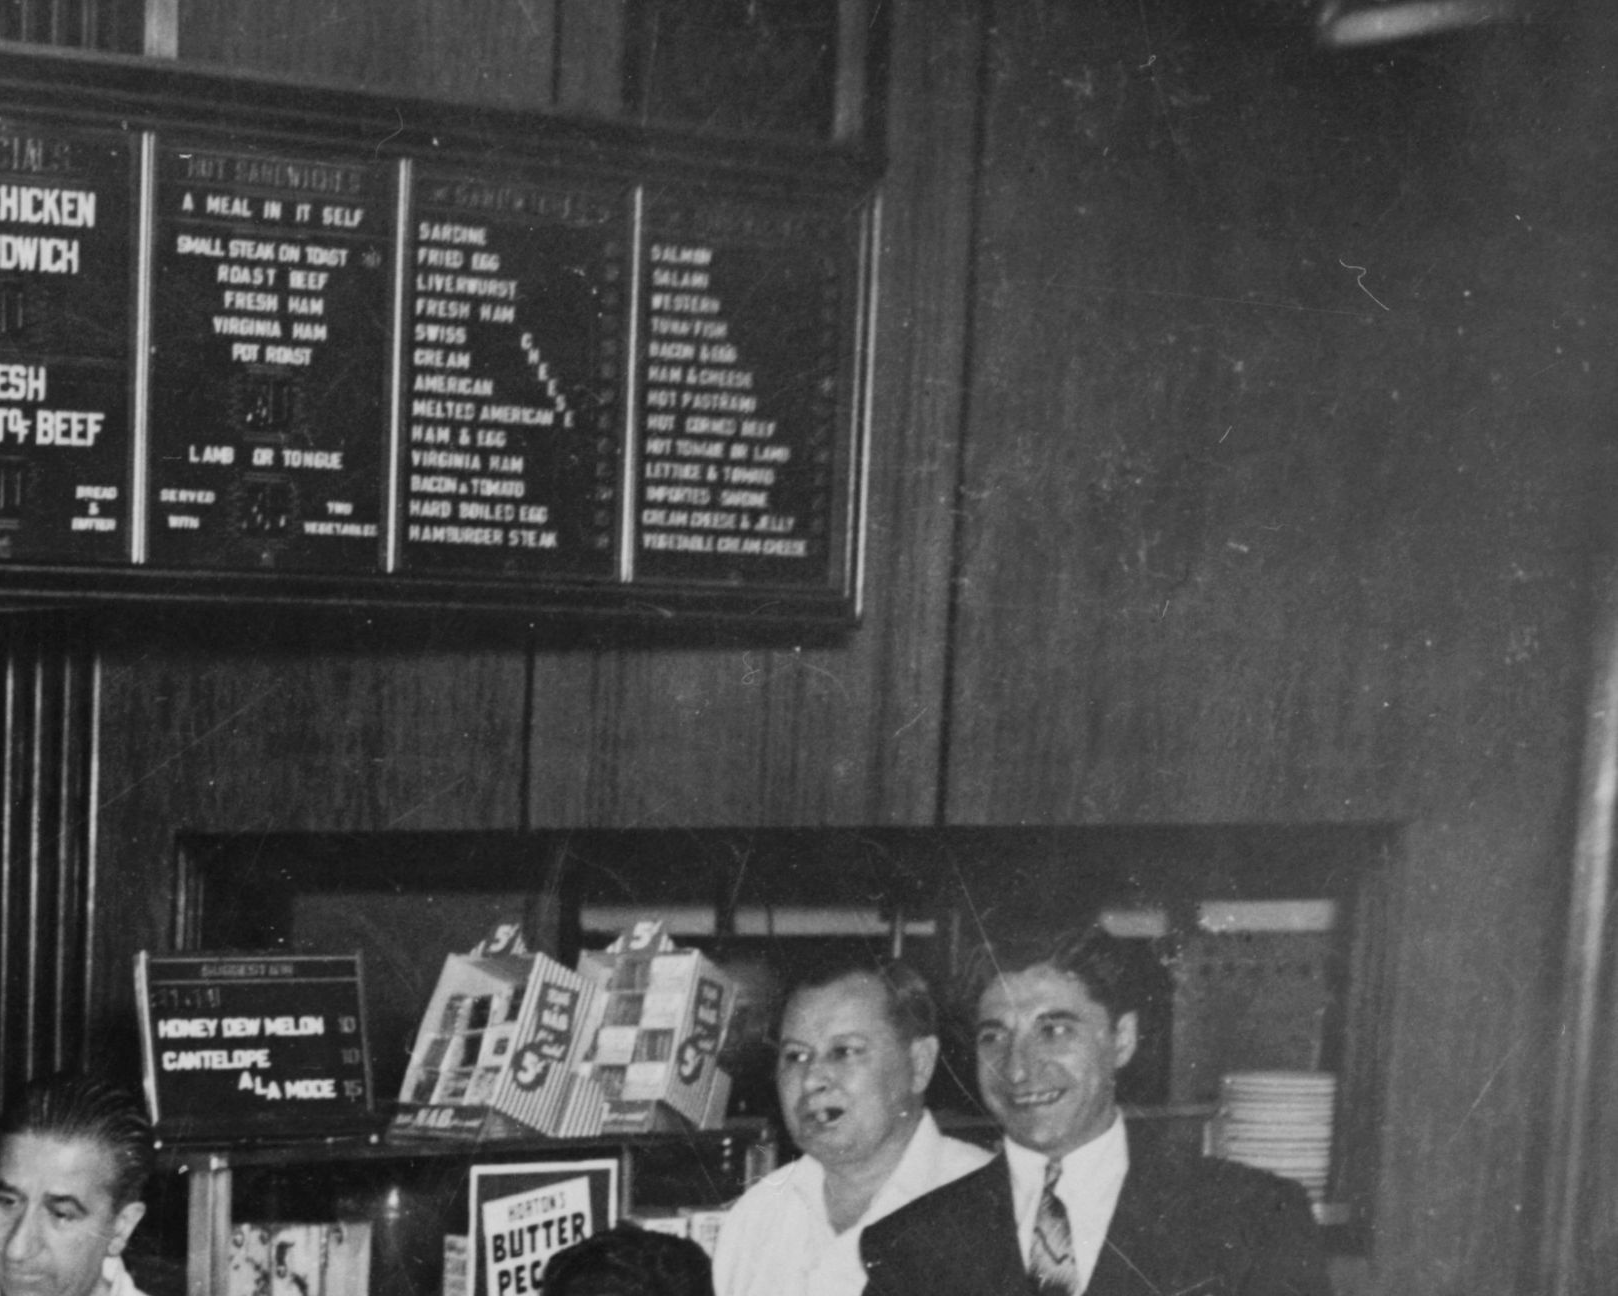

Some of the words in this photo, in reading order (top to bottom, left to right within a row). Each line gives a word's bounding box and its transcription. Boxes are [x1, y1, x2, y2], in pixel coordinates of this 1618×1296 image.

[182, 192, 194, 212] A
[206, 195, 252, 217] MEAL
[263, 200, 282, 220] IN
[296, 202, 311, 223] IT
[322, 206, 364, 228] SELF
[417, 247, 464, 269] FRIED
[471, 252, 500, 272] EGG
[217, 266, 277, 286] ROAST
[289, 269, 329, 291] BEEF
[415, 299, 471, 319] FRESH
[479, 303, 516, 324] HAM
[413, 374, 493, 396] AMERICAN
[521, 333, 574, 429] CHEESE
[8, 408, 31, 444] OF
[36, 410, 105, 447] BEEF
[158, 1017, 218, 1038] HONEY
[221, 1017, 261, 1038] DEW
[264, 1016, 325, 1036] MELON
[162, 1049, 271, 1070] CANTELOPE
[238, 1071, 253, 1090] A
[255, 1076, 282, 1100] LA
[284, 1079, 337, 1099] MODE
[492, 1212, 587, 1264] BUTTER
